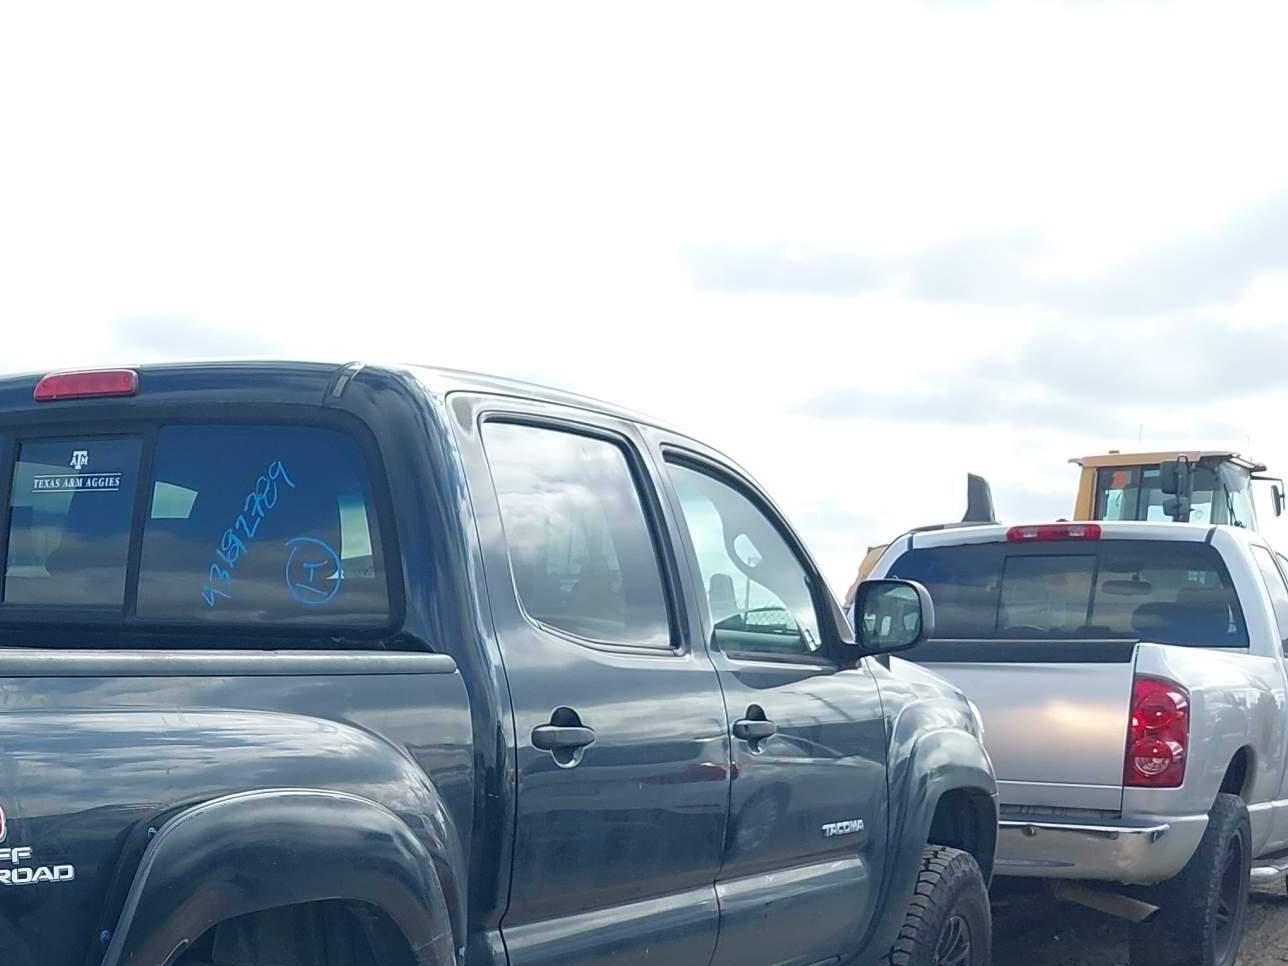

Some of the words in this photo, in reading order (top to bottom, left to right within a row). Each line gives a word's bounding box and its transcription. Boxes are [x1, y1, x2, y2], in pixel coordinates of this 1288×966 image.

[33, 479, 60, 489] TEXAS
[63, 478, 83, 488] A&M
[86, 477, 121, 487] AGGIES
[822, 819, 864, 837] TACOMA
